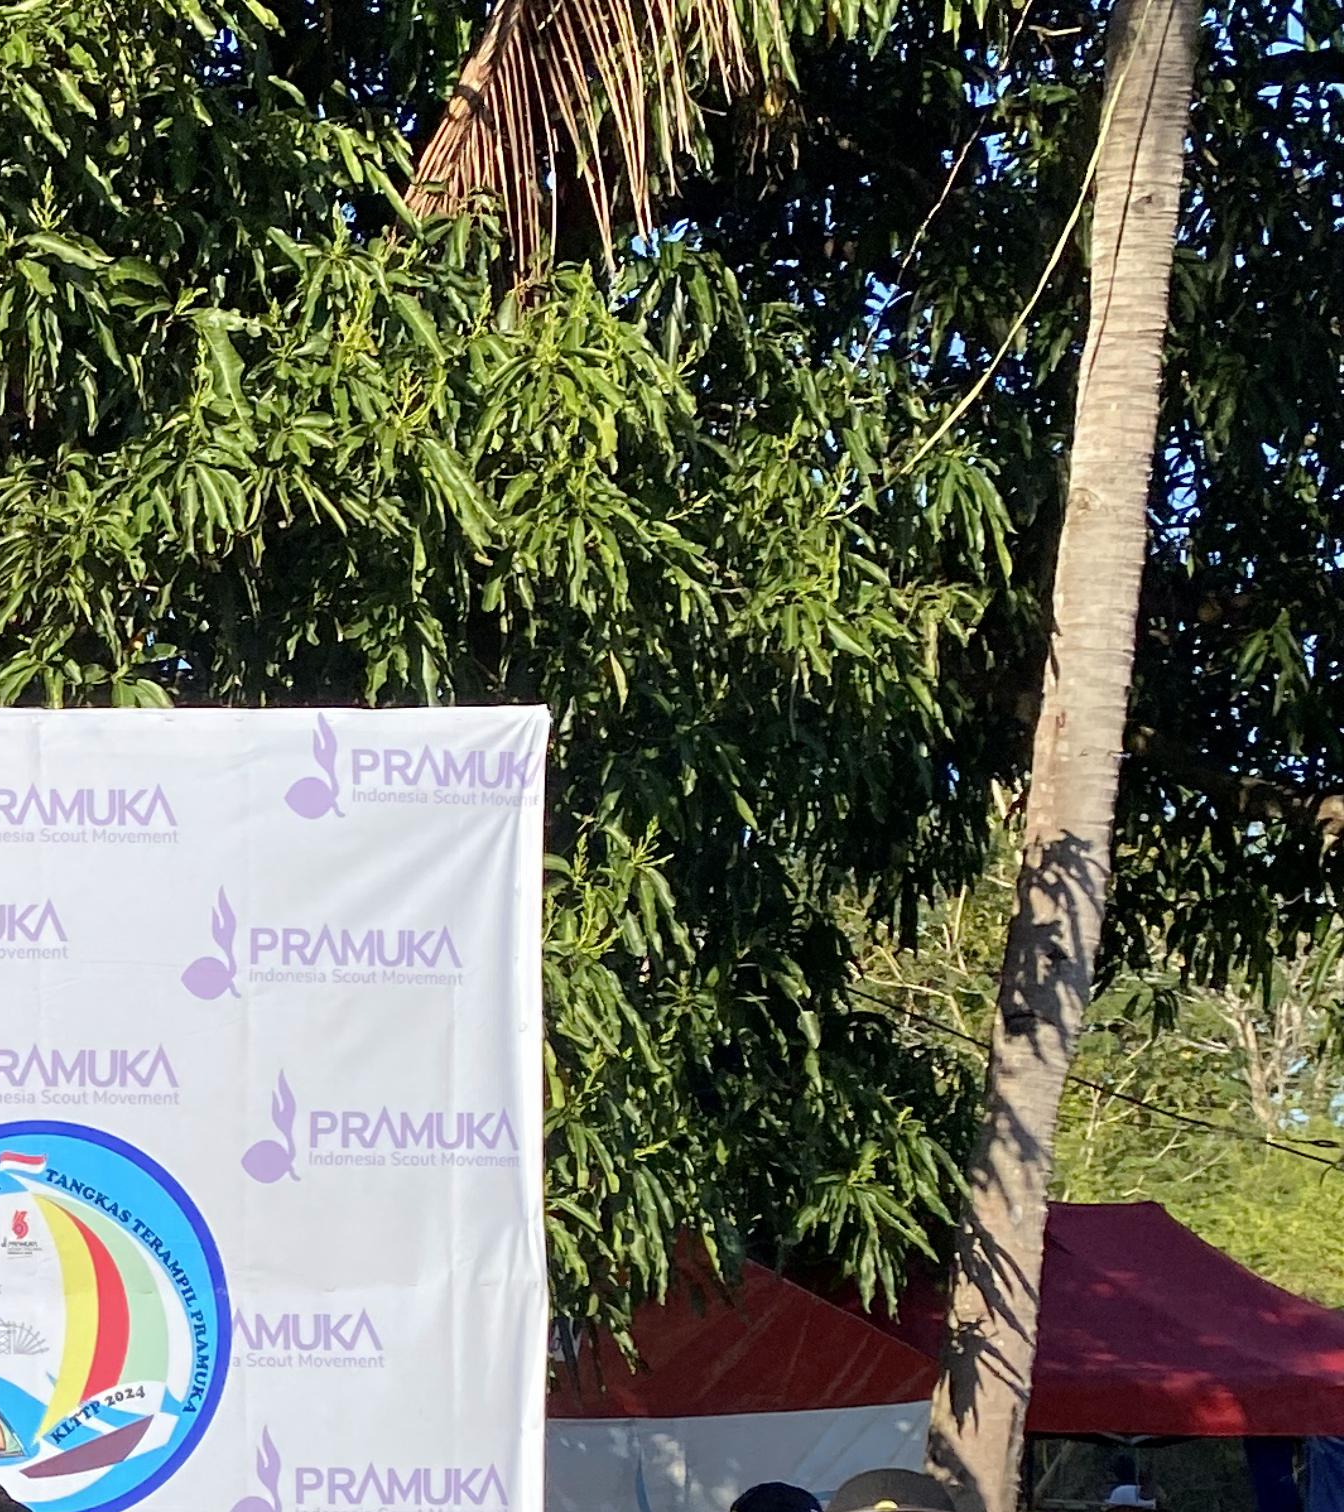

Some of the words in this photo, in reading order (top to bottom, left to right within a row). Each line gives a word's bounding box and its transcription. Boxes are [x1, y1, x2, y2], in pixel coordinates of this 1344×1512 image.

[352, 787, 428, 803] Indonesia
[433, 789, 477, 805] Scout
[39, 829, 90, 844] Scout
[92, 829, 179, 844] Movement
[248, 924, 462, 970] PRAMUKA
[248, 969, 327, 985] Indonesia
[331, 970, 377, 985] Scout
[382, 970, 464, 986] Movement
[41, 1090, 90, 1105] Scout
[92, 1090, 180, 1105] Movement
[308, 1107, 519, 1153] PRAMUKA
[309, 1153, 386, 1167] Indonesia
[390, 1153, 439, 1167] Scout
[46, 1168, 132, 1222] TANGKAS
[133, 1218, 193, 1308] TERAMPIL
[182, 1310, 211, 1413] PRAMUKA
[232, 1308, 384, 1351] AMUKA
[246, 1353, 293, 1368] Scout
[298, 1354, 385, 1369] Movement
[50, 1400, 101, 1444] KLTTP
[104, 1385, 146, 1407] 2024
[295, 1463, 509, 1506] PRAMUKA
